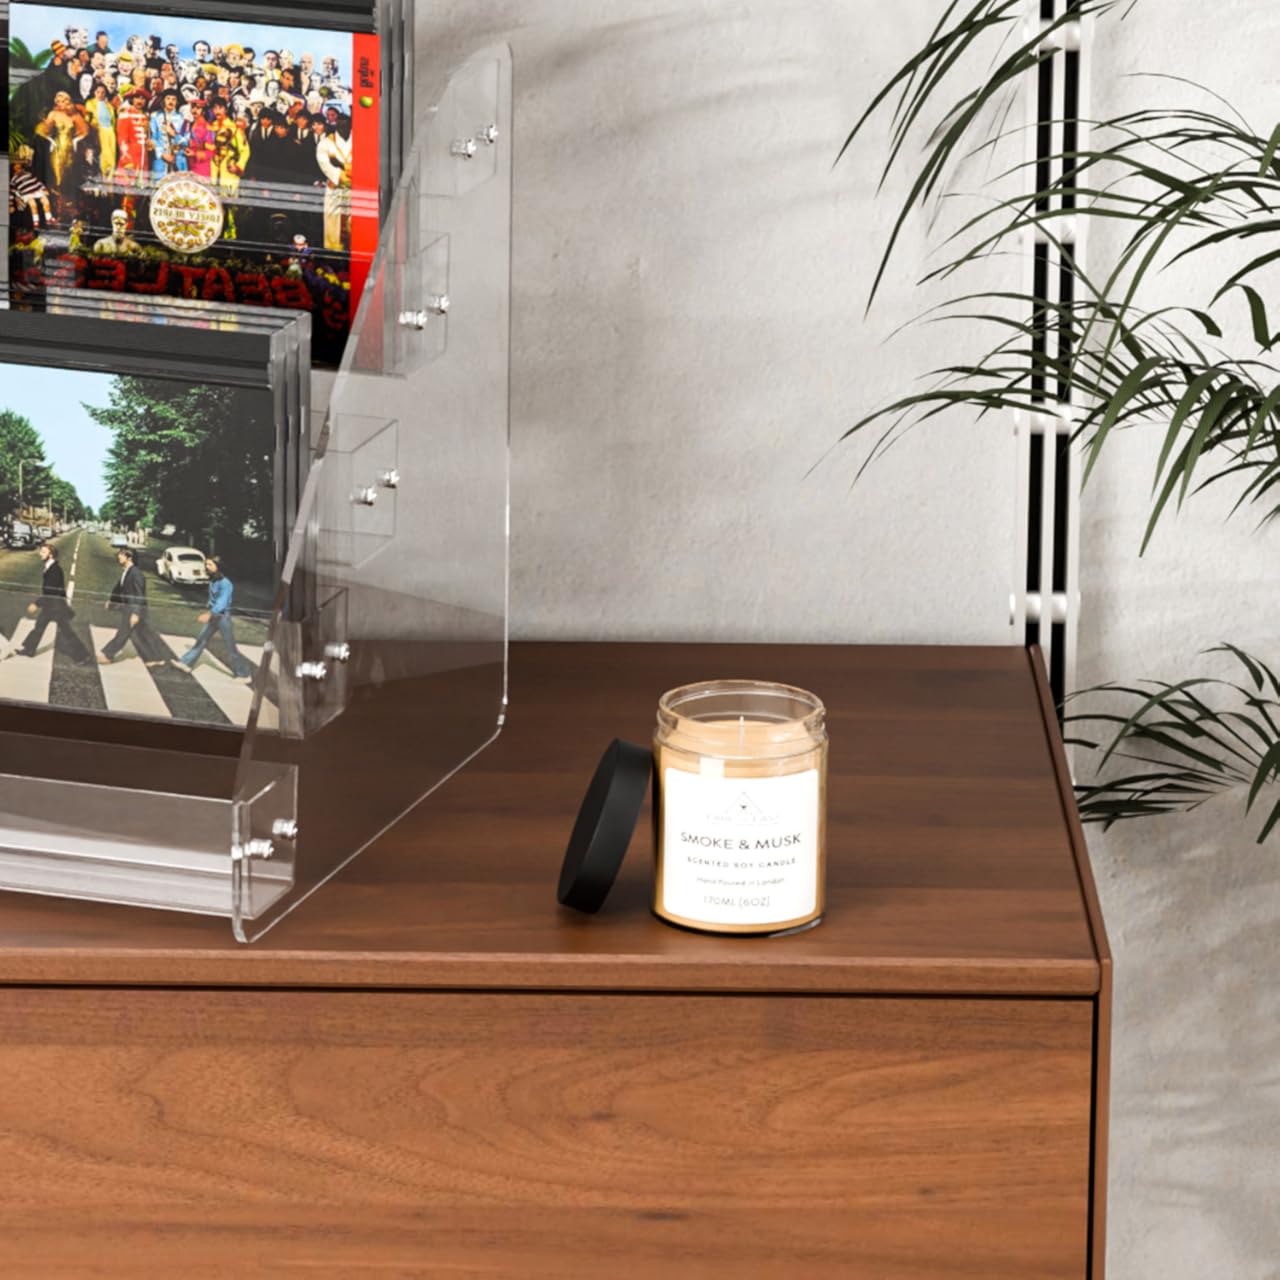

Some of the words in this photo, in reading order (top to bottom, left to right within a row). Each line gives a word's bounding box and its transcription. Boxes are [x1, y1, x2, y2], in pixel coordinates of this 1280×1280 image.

[680, 831, 734, 850] SMOKE
[738, 839, 750, 850] &
[754, 831, 802, 850] MUSK
